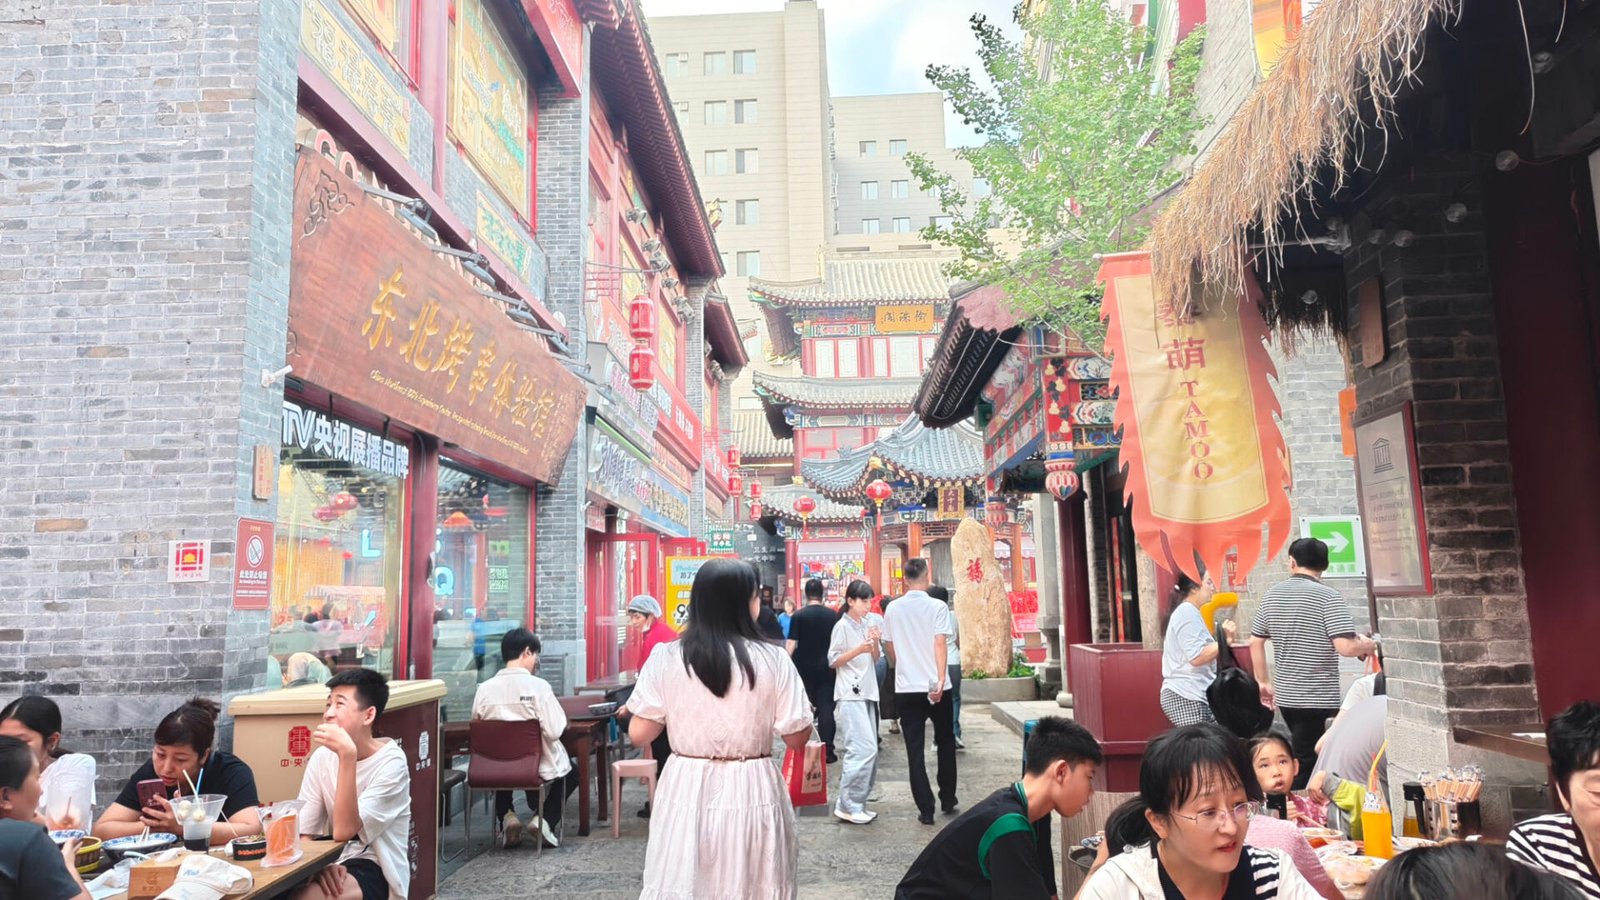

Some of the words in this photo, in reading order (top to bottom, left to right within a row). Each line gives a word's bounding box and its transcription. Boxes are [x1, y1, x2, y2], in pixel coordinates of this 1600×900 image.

[314, 414, 409, 480] 央视展播品牌
[1180, 380, 1214, 481] TAMOO
